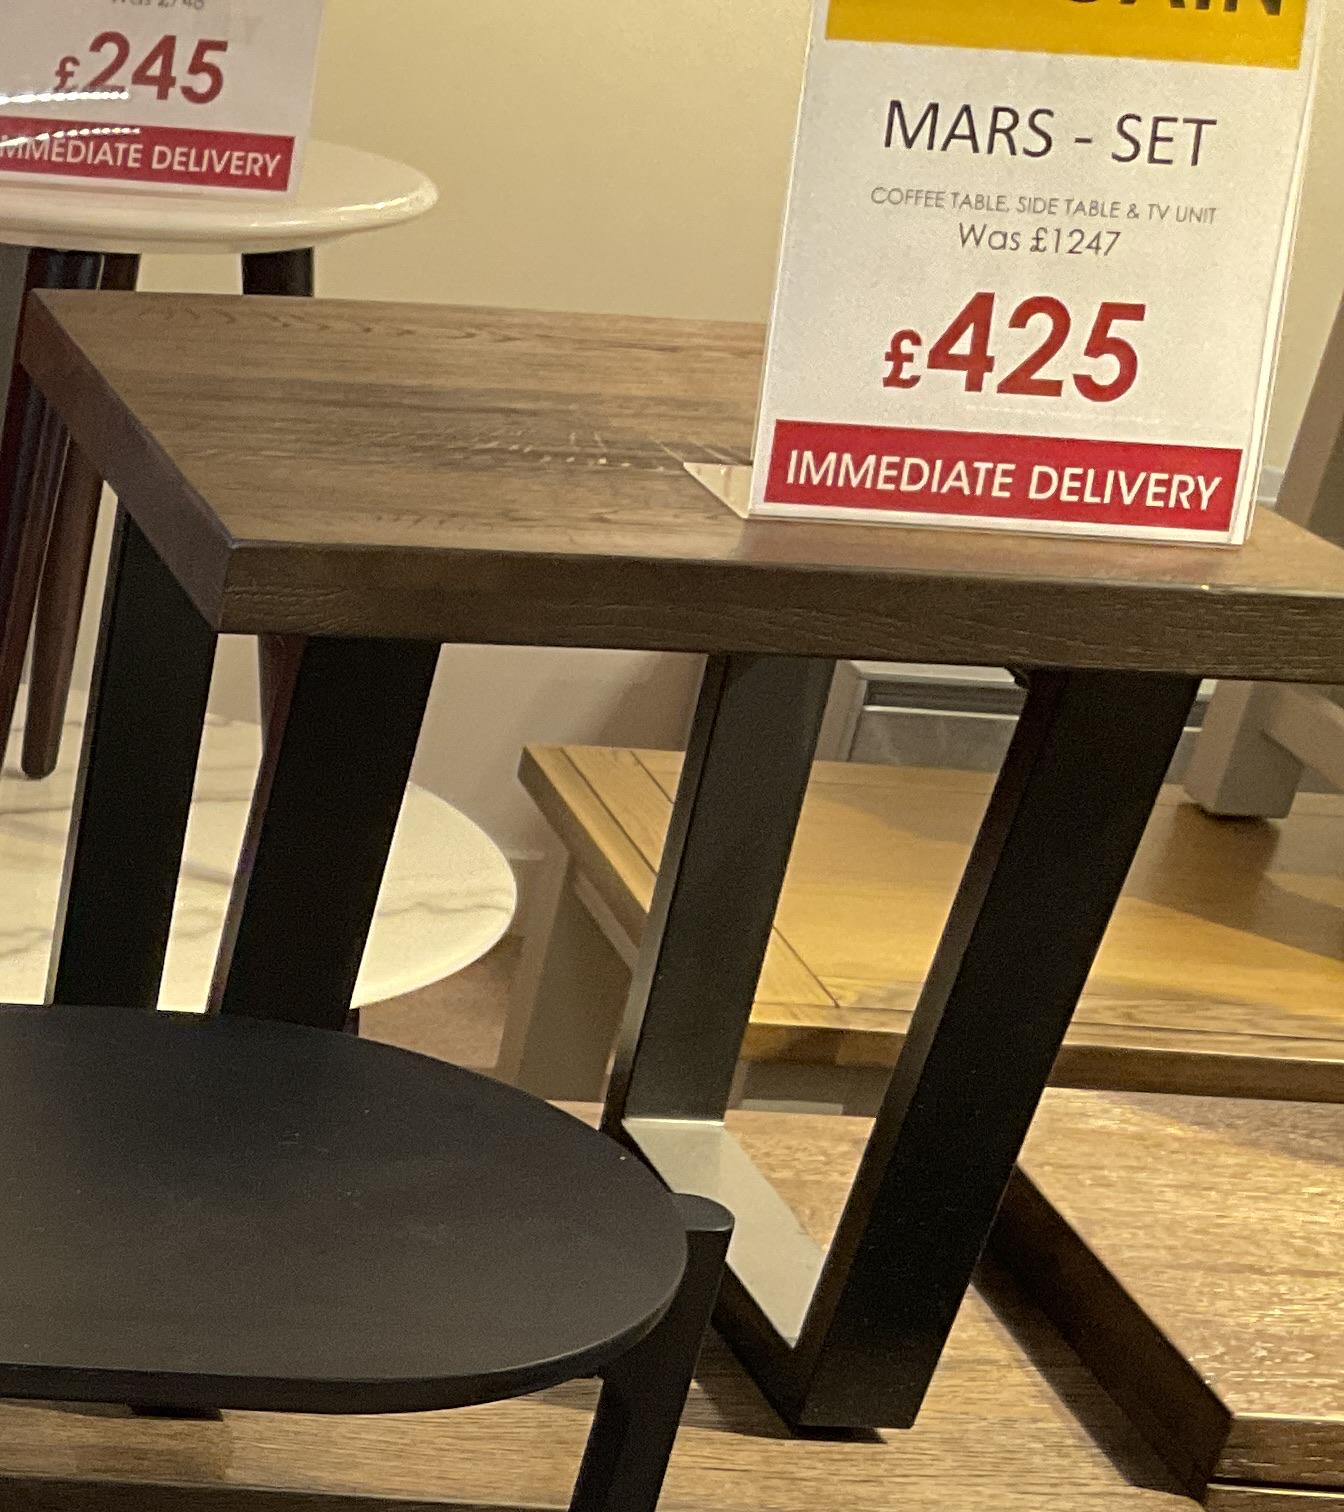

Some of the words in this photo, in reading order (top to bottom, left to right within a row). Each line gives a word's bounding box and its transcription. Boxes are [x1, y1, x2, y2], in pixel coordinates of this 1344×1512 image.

[53, 30, 229, 105] £245
[151, 145, 282, 178] DELIVERY
[883, 100, 1055, 159] MARS
[1074, 136, 1093, 145] -
[1111, 113, 1218, 167] SET
[870, 186, 947, 209] COFFEE
[1016, 195, 1060, 216] SIDE
[1063, 198, 1121, 219] TABLE
[1126, 202, 1140, 220] &
[1148, 203, 1171, 221] TV
[1175, 205, 1217, 226] UNIT
[958, 221, 1021, 252] Was
[1029, 226, 1123, 257] £1247
[881, 290, 1147, 403] £425
[785, 449, 1016, 499] IMMEDIATE
[1027, 464, 1223, 512] DELIVERY
